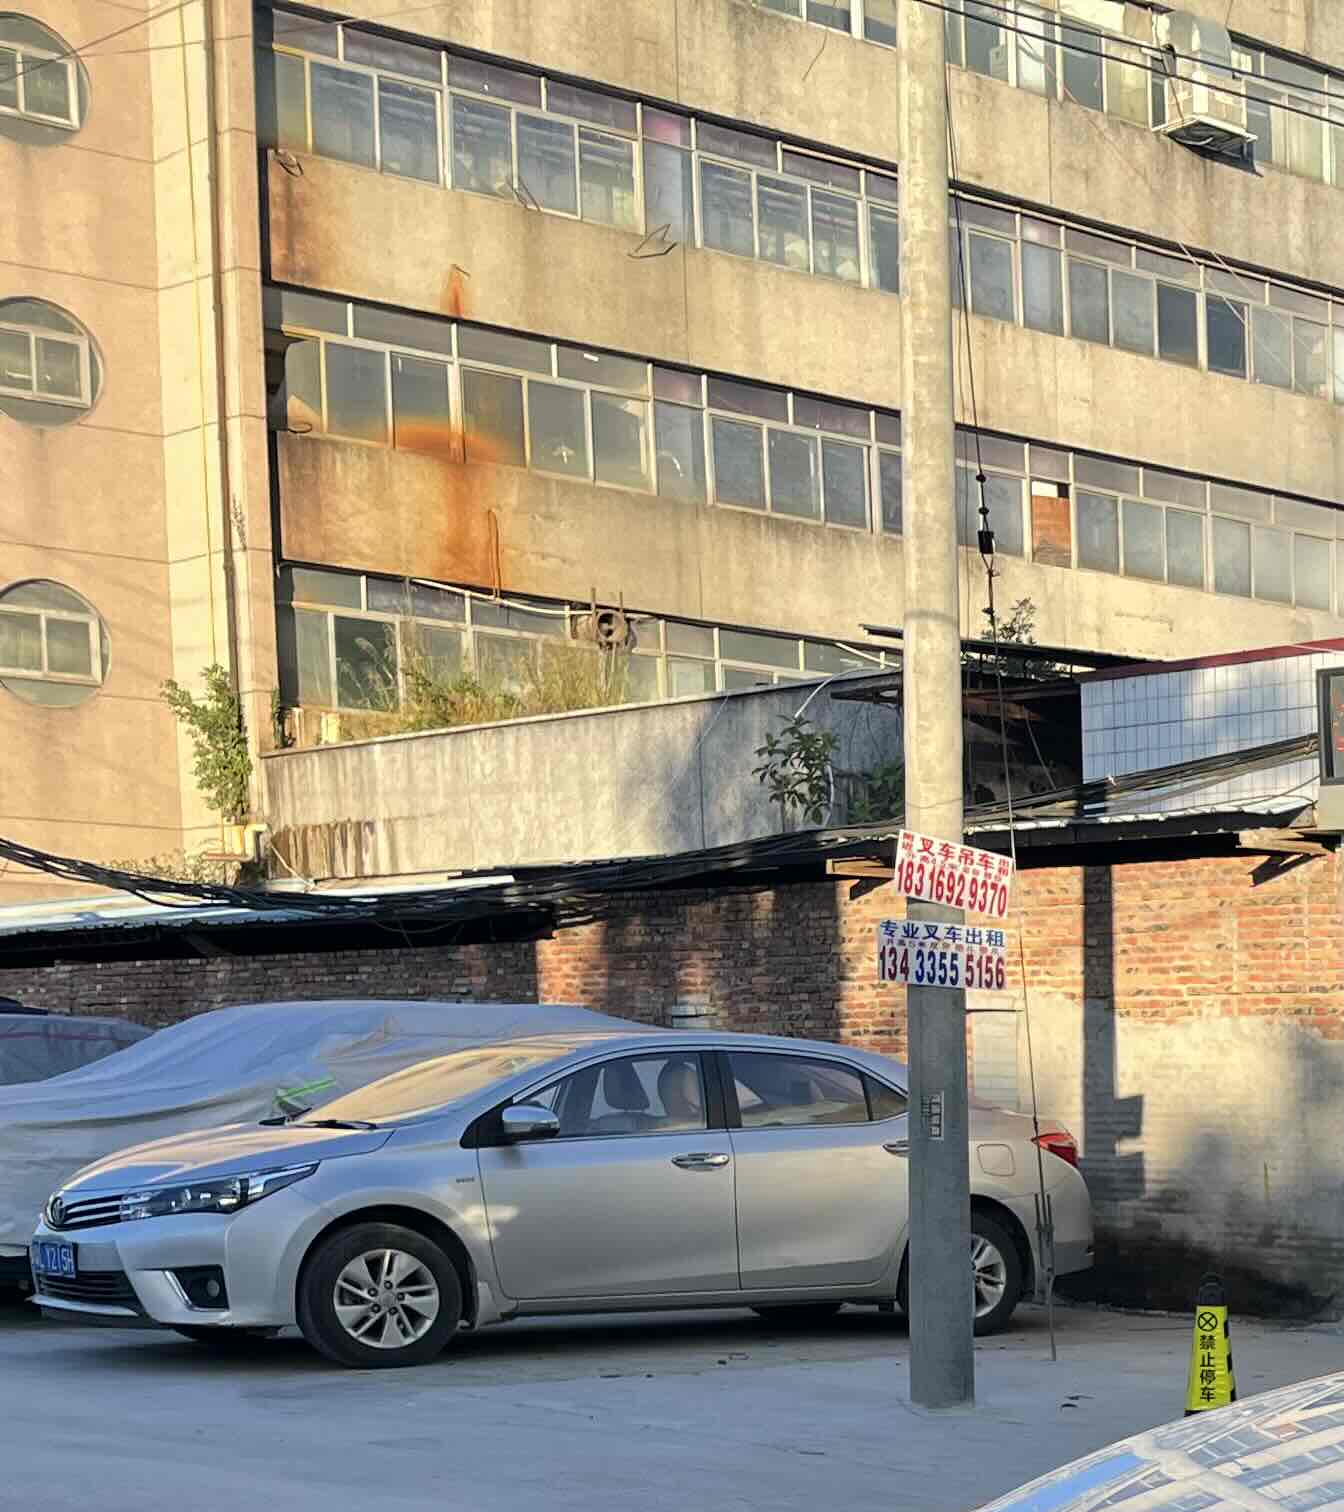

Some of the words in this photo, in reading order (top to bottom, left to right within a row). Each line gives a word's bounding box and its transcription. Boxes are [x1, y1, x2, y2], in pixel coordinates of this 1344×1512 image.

[917, 837, 995, 871] 叉车吊车
[898, 857, 925, 897] 183
[929, 863, 966, 907] 1692
[968, 877, 1007, 918] 9370
[879, 919, 1005, 948] 专业叉车出租
[879, 945, 910, 982] 134
[915, 948, 960, 986] 3355
[965, 953, 1005, 990] 5156
[1199, 1334, 1216, 1403] 禁止停车
